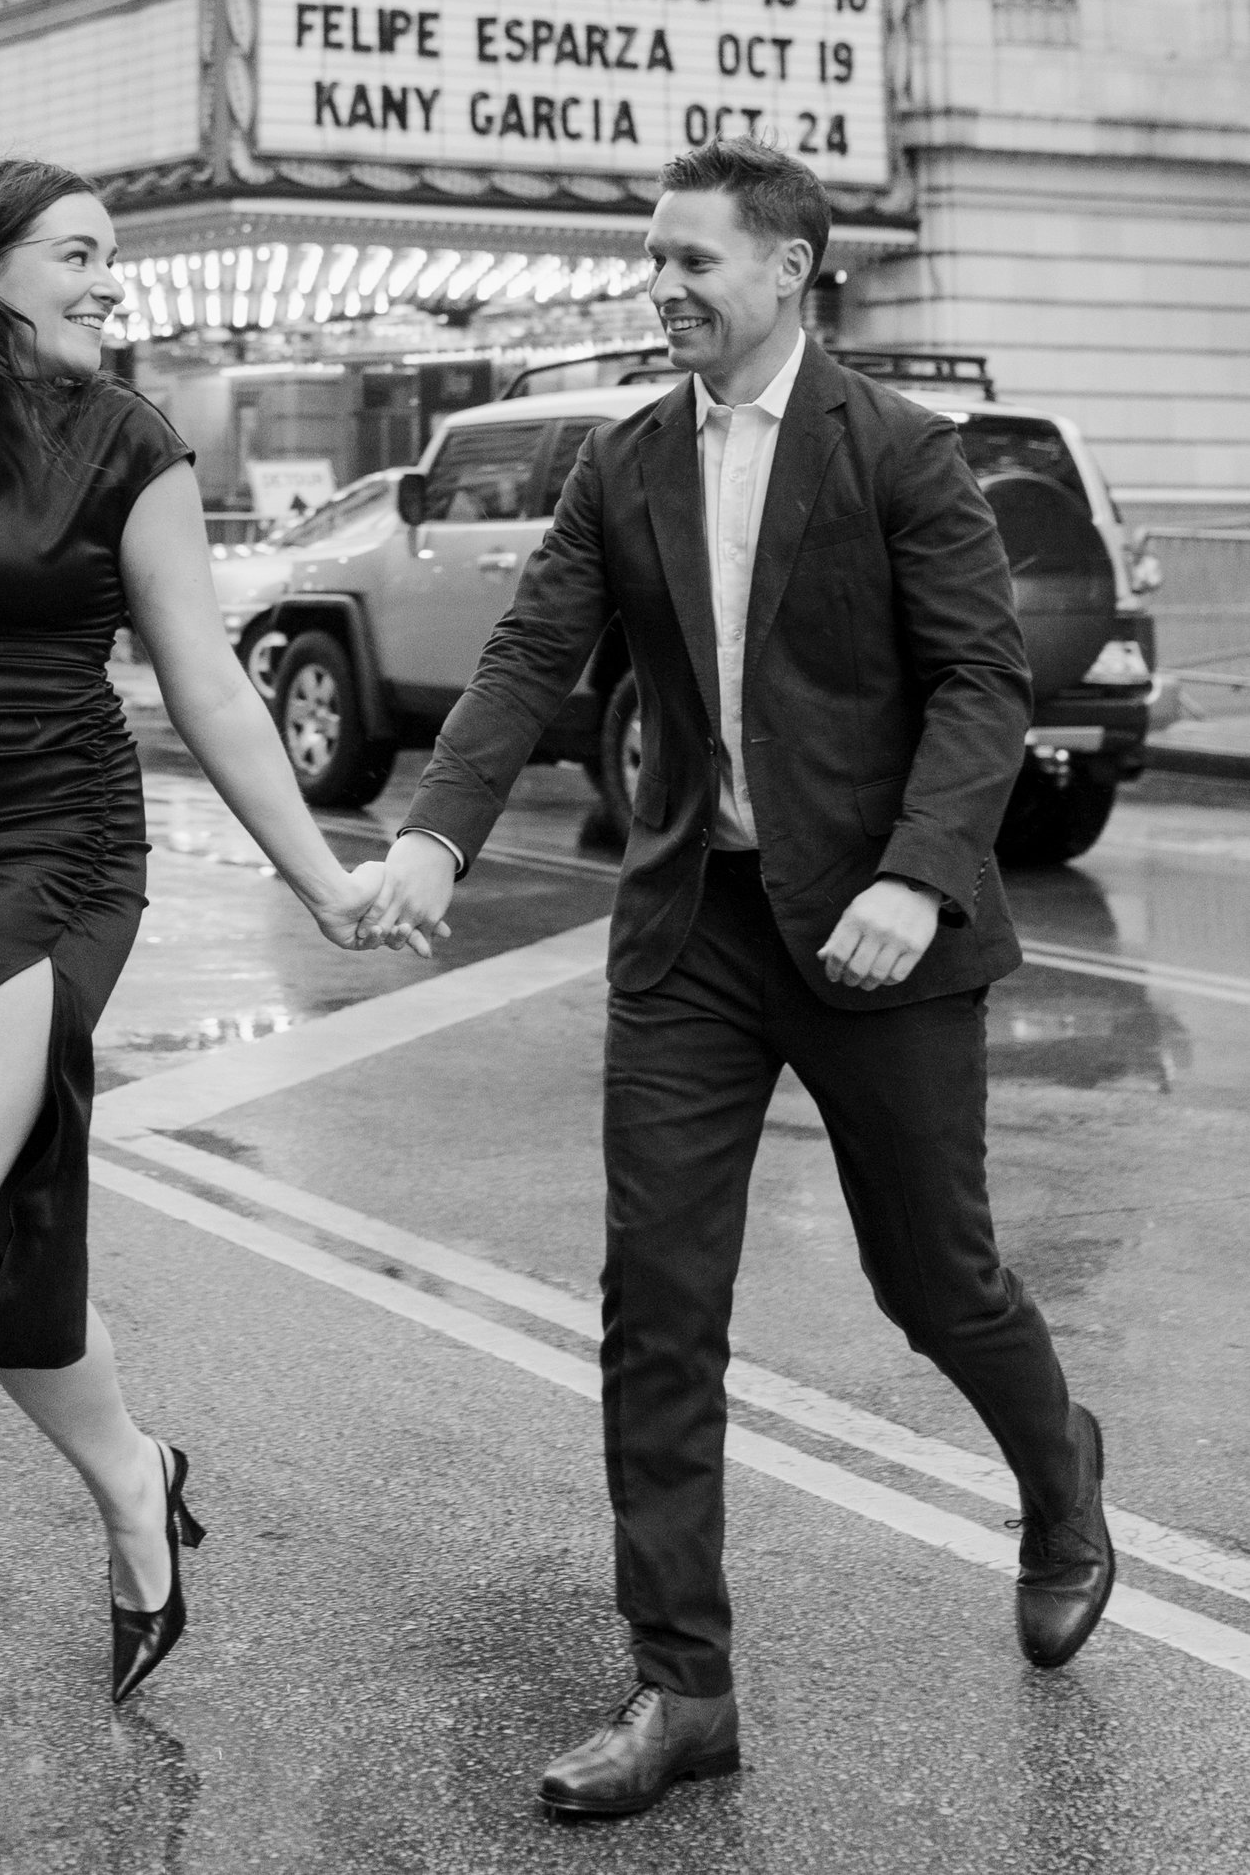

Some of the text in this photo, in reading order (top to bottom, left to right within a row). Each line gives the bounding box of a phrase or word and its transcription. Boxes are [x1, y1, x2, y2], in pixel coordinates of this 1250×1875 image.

[294, 3, 852, 84] FELIPE ESPARZA OCT 19
[313, 80, 848, 156] KANY GARCIA OCT 24
